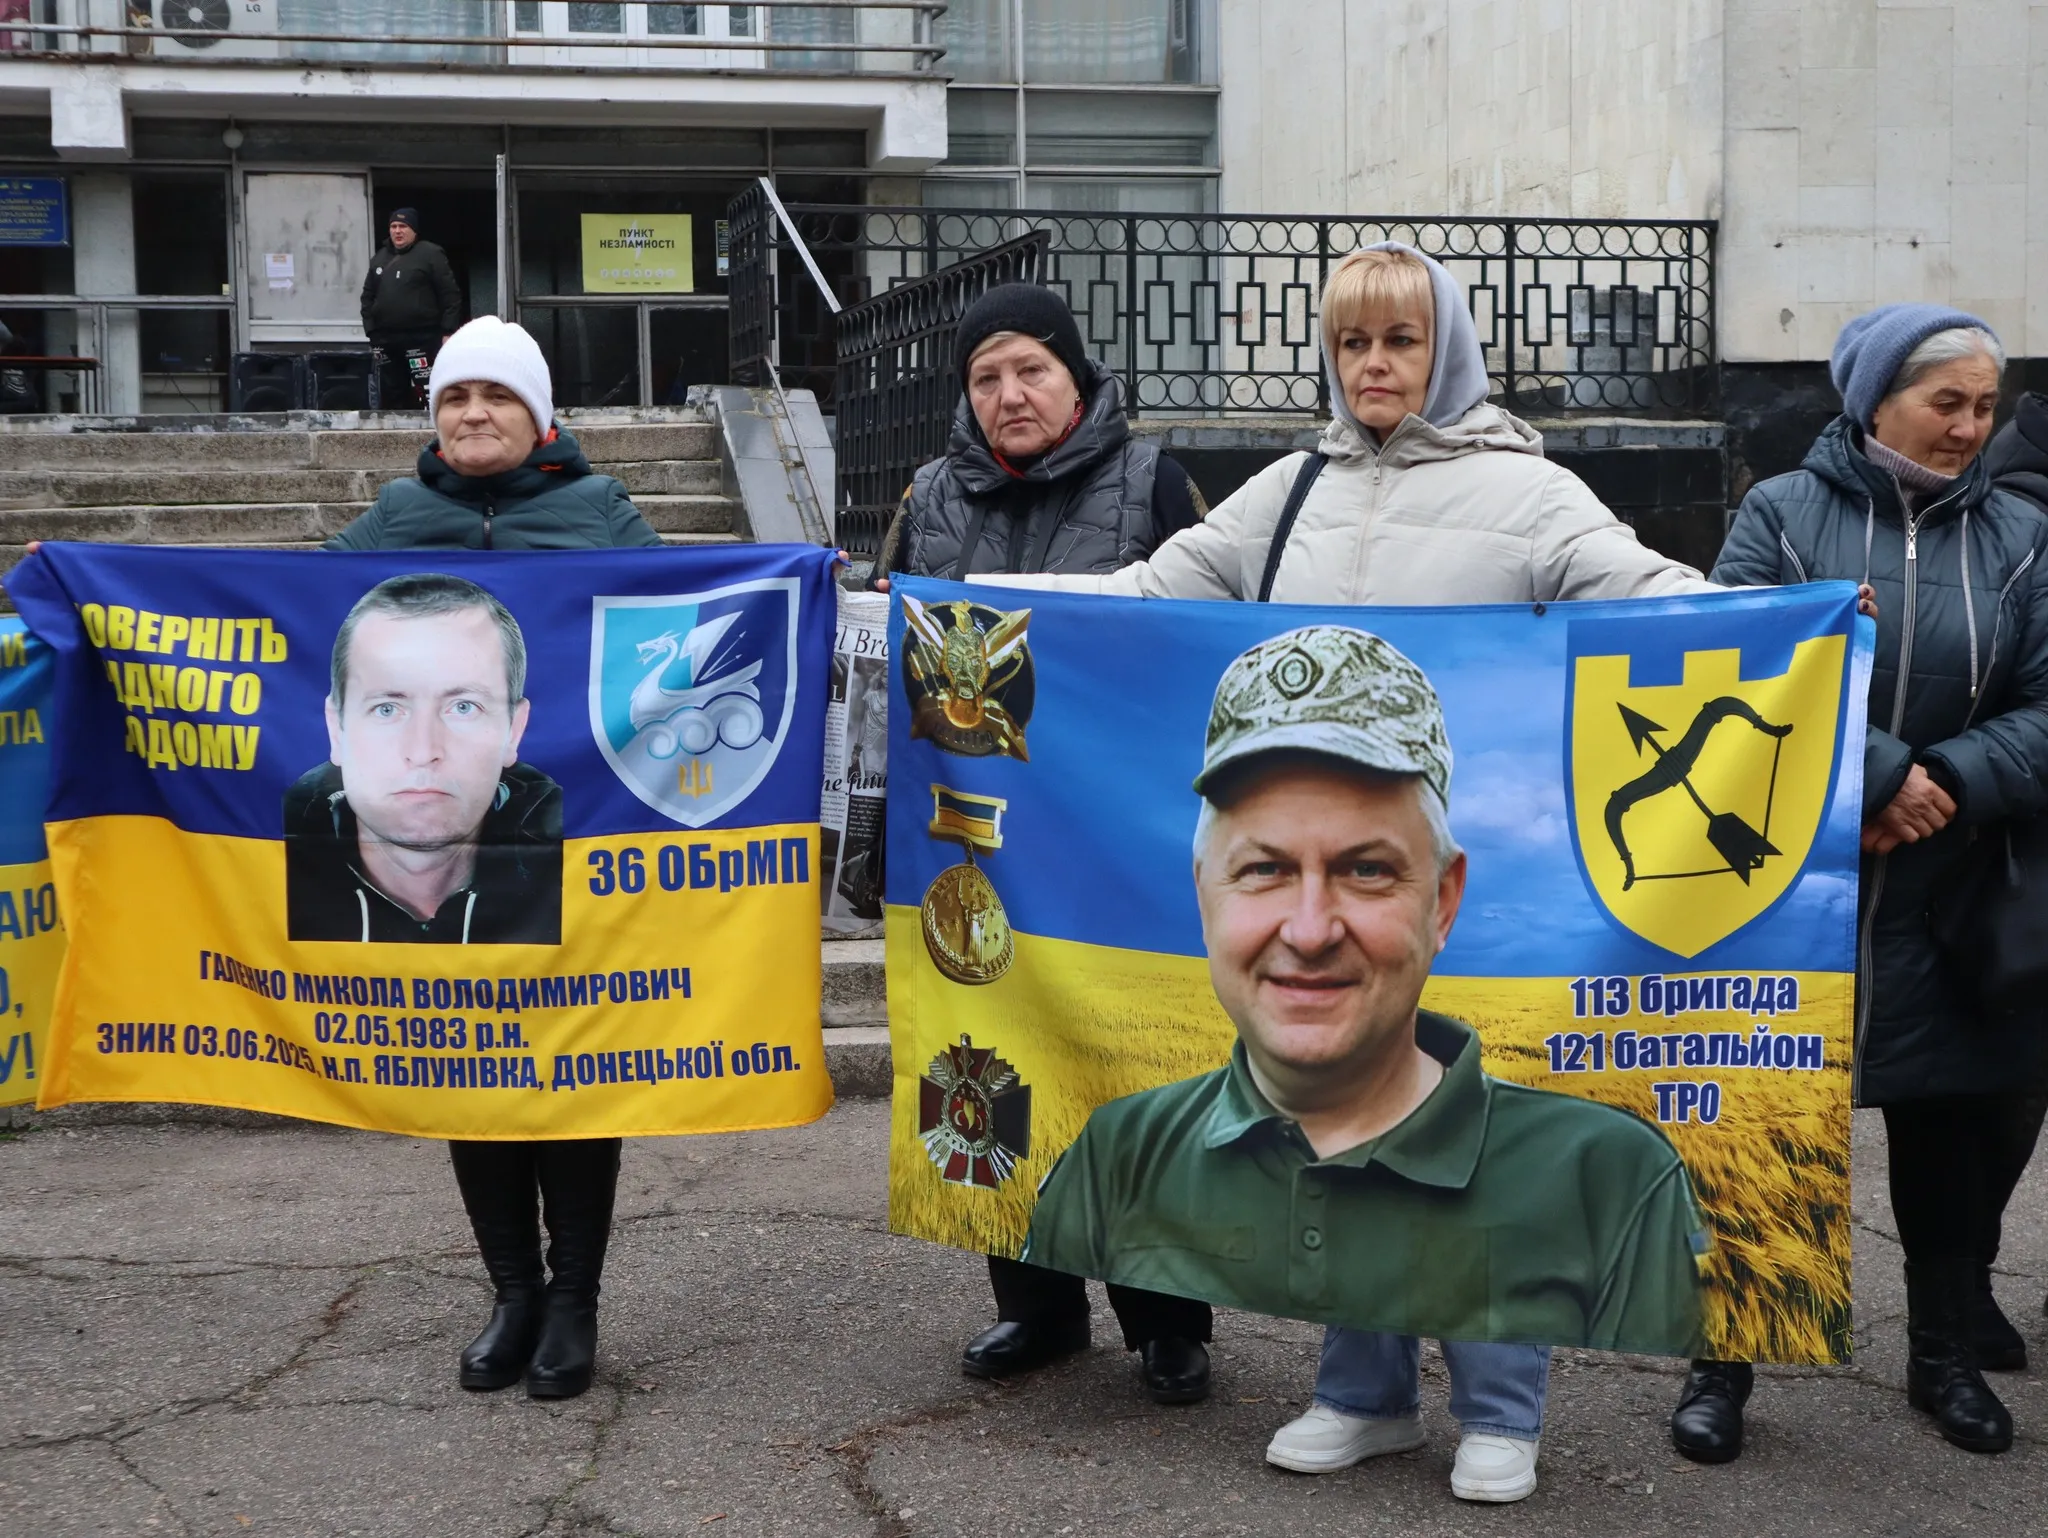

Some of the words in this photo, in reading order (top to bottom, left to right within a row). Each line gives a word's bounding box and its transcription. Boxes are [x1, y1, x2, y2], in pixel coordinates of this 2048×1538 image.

[245, 3, 261, 13] LG
[599, 239, 675, 249] НЕЗЛАМНОСТІ
[619, 228, 655, 238] ПУНКТ
[74, 602, 288, 663] ОВЕРНІТЬ
[103, 660, 262, 716] ІДНОГО
[587, 847, 646, 897] 36
[657, 837, 810, 893] ОБрМП
[200, 950, 287, 1001] ГАЛЕНКО
[293, 972, 407, 1010] МИКОЛА
[412, 967, 693, 1014] ВОЛОДИМИРОВИЧ
[1569, 975, 1631, 1018] 113
[1638, 974, 1799, 1018] бригада
[314, 1011, 468, 1050] 02.05.1983
[476, 1021, 530, 1052] р.н.
[1545, 1030, 1606, 1073] 121
[1612, 1024, 1823, 1072] батальйон
[96, 1022, 176, 1054] ЗНИК
[183, 1024, 322, 1079] 03.06.2025,
[321, 1056, 368, 1084] н.п.
[374, 1054, 545, 1091] ЯБЛУНІВКА,
[551, 1040, 724, 1092] ДОНЕЦЬКОЇ
[731, 1042, 801, 1077] обл.
[1652, 1081, 1721, 1125] ТРО
